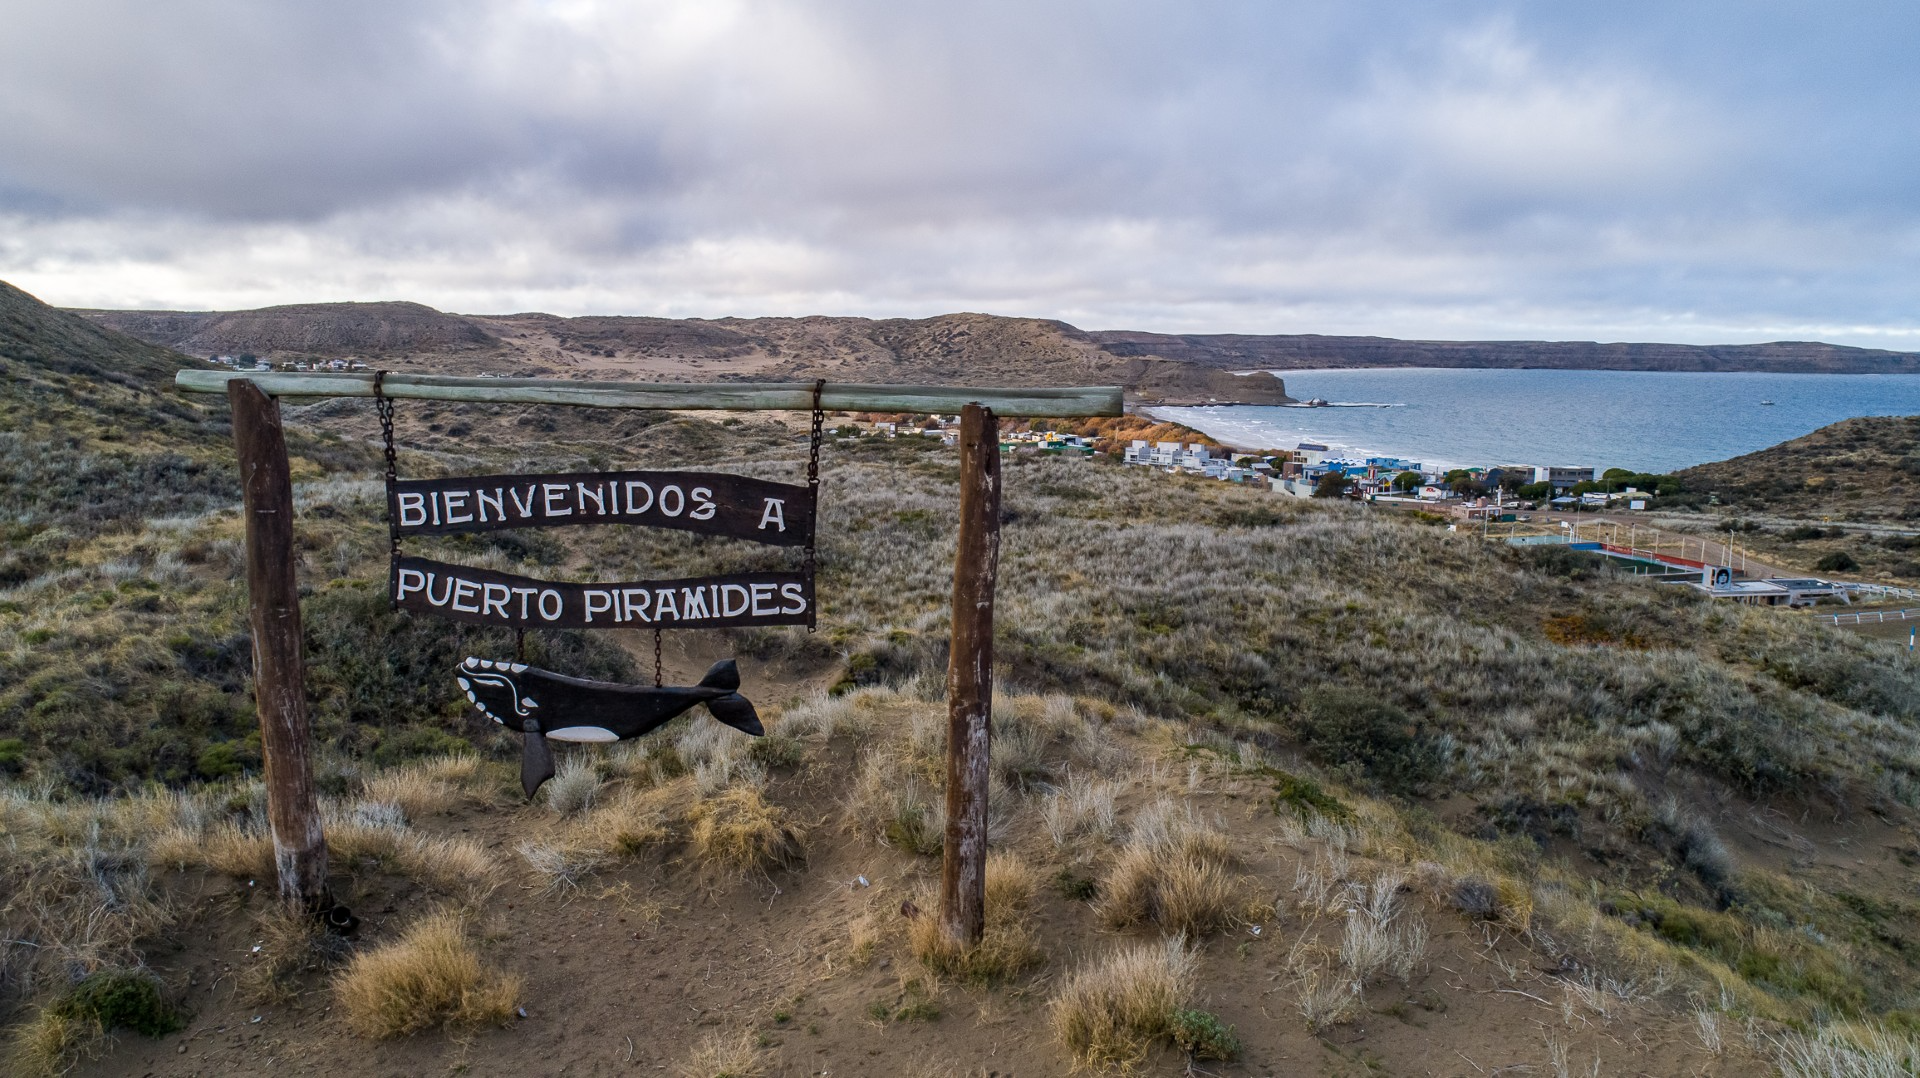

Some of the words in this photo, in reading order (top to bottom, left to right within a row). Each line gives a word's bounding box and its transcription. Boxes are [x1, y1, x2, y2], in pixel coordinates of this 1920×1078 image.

[398, 481, 717, 526] BIENVENIDOS
[757, 497, 786, 532] A
[397, 568, 563, 621] PUERTO
[583, 583, 807, 623] PIRAMIDES
